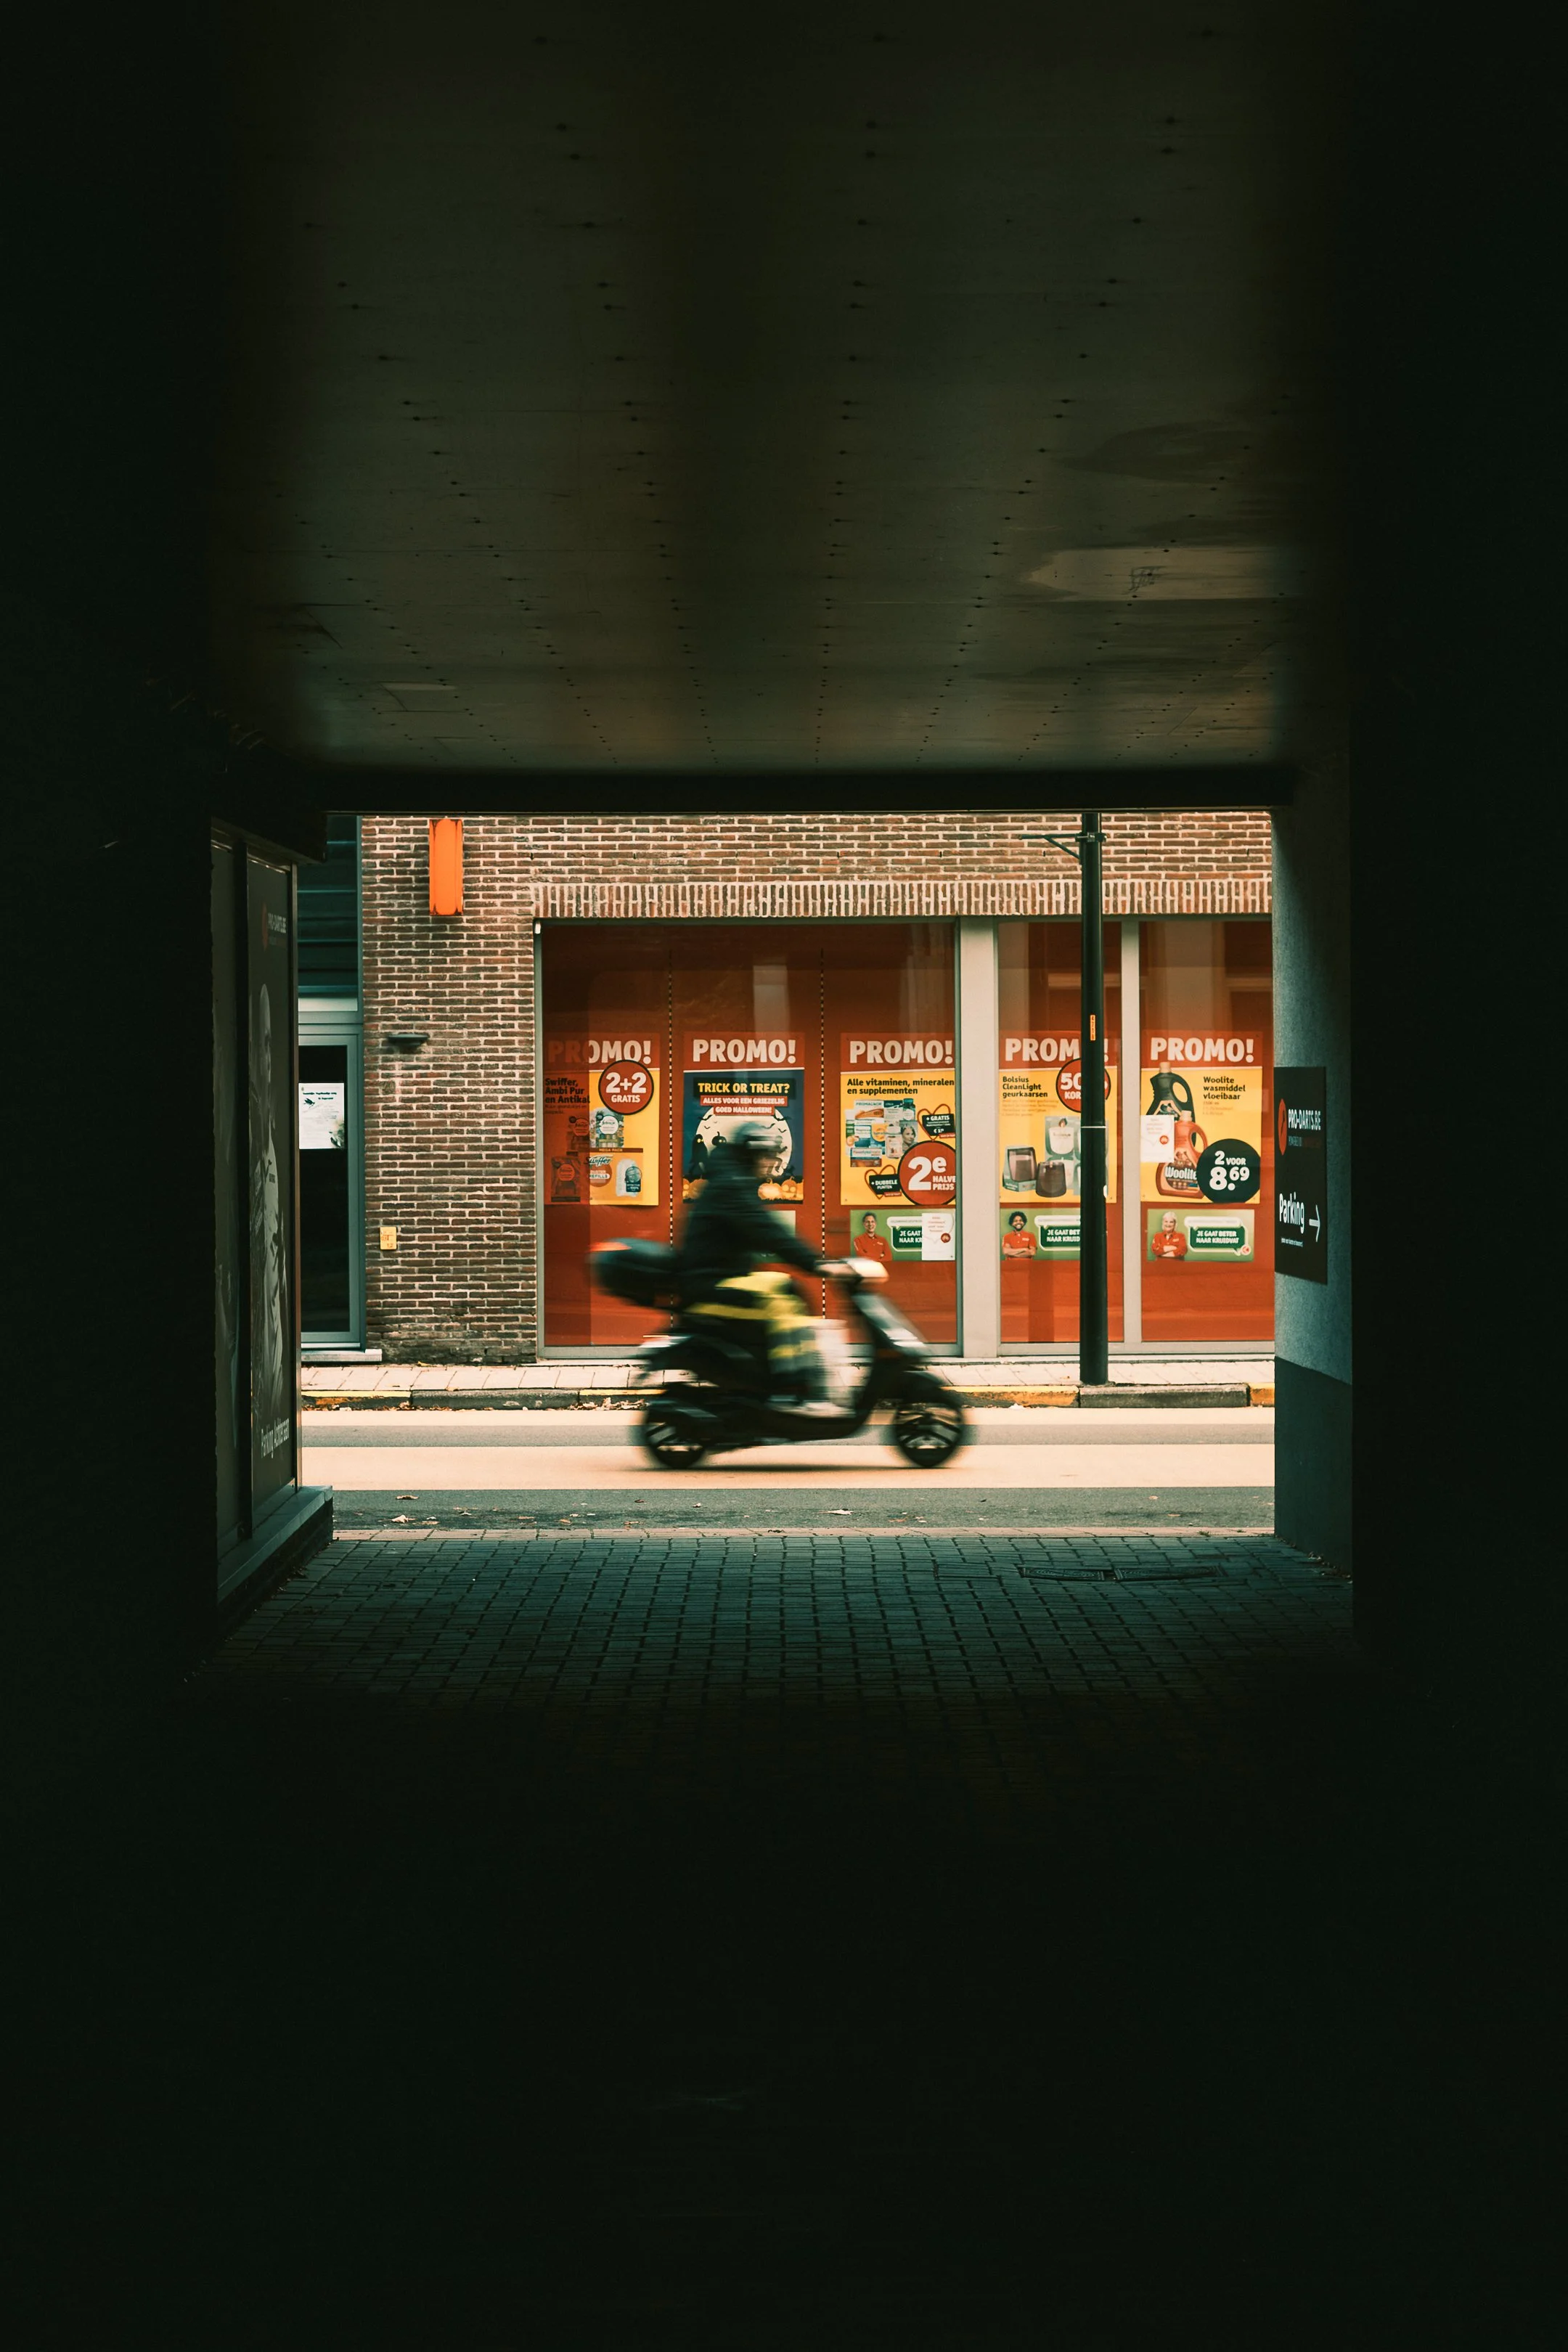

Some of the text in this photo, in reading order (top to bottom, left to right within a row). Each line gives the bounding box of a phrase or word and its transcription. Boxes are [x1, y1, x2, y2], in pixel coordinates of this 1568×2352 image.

[693, 1039, 796, 1064] PROMO!
[849, 1040, 953, 1064] PROMO!
[1005, 1038, 1109, 1063] PROM!
[1150, 1037, 1254, 1063] PROMO!
[544, 1077, 579, 1087] Swiffer,
[605, 1071, 647, 1093] 2+2
[698, 1082, 791, 1094] TRICK OR TREAT?
[866, 1078, 910, 1087] vitaminen,
[912, 1077, 955, 1086] mineralen
[1003, 1082, 1042, 1092] CleanLight
[544, 1086, 568, 1095] Ambi
[859, 1087, 918, 1096] supplementen
[1064, 1091, 1082, 1100] KOR
[558, 1095, 590, 1103] Antikal
[611, 1094, 641, 1103] GRATIS
[1288, 1108, 1321, 1131] PRO-DARTS.BE
[1214, 1150, 1246, 1166] 2 VOOR
[1279, 1191, 1304, 1234] Parking
